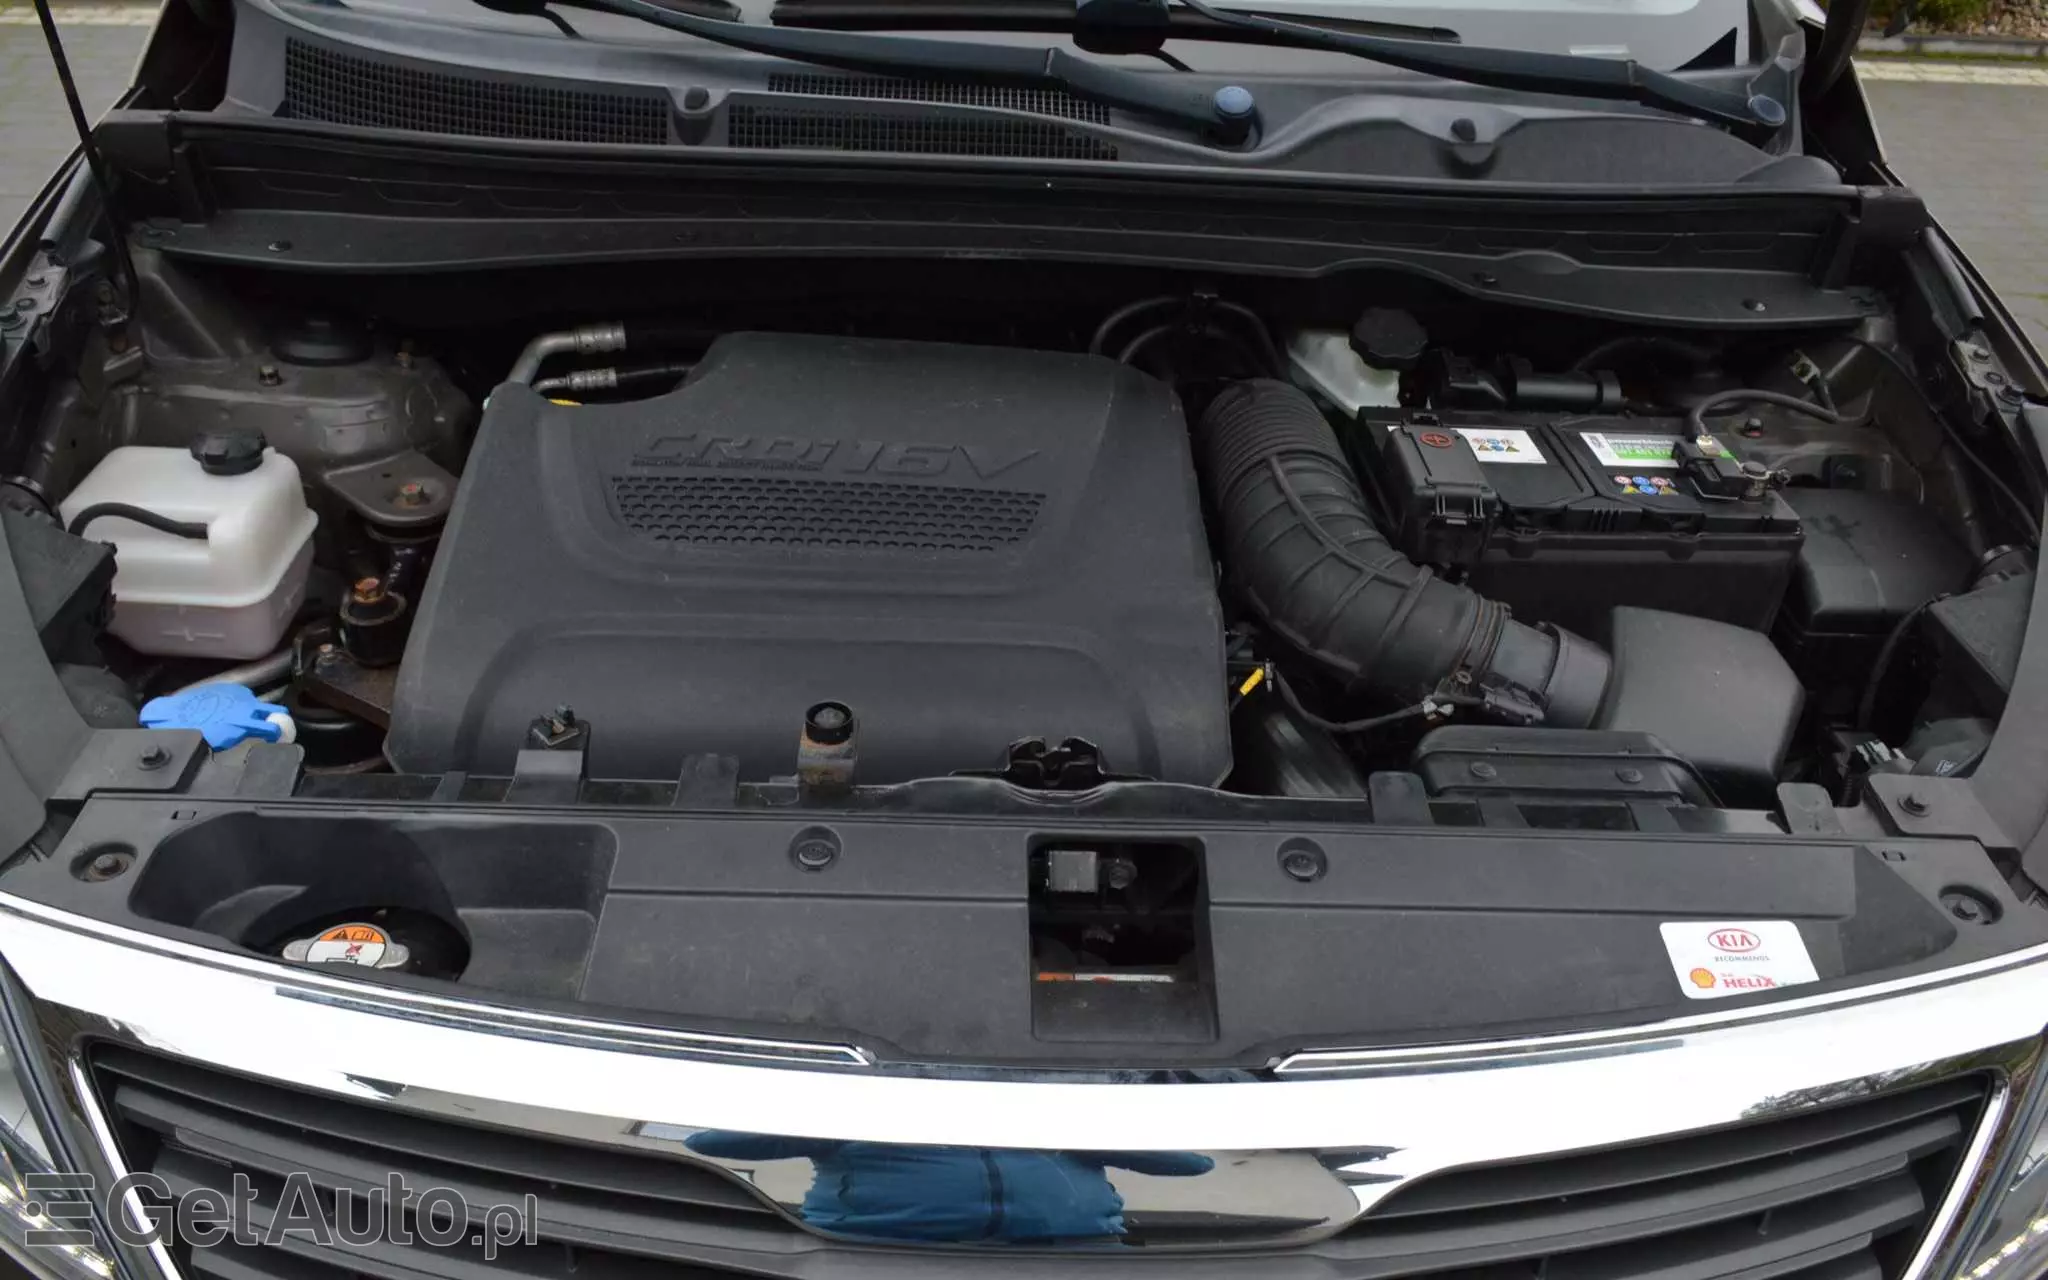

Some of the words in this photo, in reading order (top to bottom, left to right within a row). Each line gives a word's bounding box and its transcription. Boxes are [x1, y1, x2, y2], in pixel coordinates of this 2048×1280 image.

[842, 440, 1041, 481] 16V
[1716, 934, 1753, 947] KIA
[1722, 977, 1776, 988] HELIX
